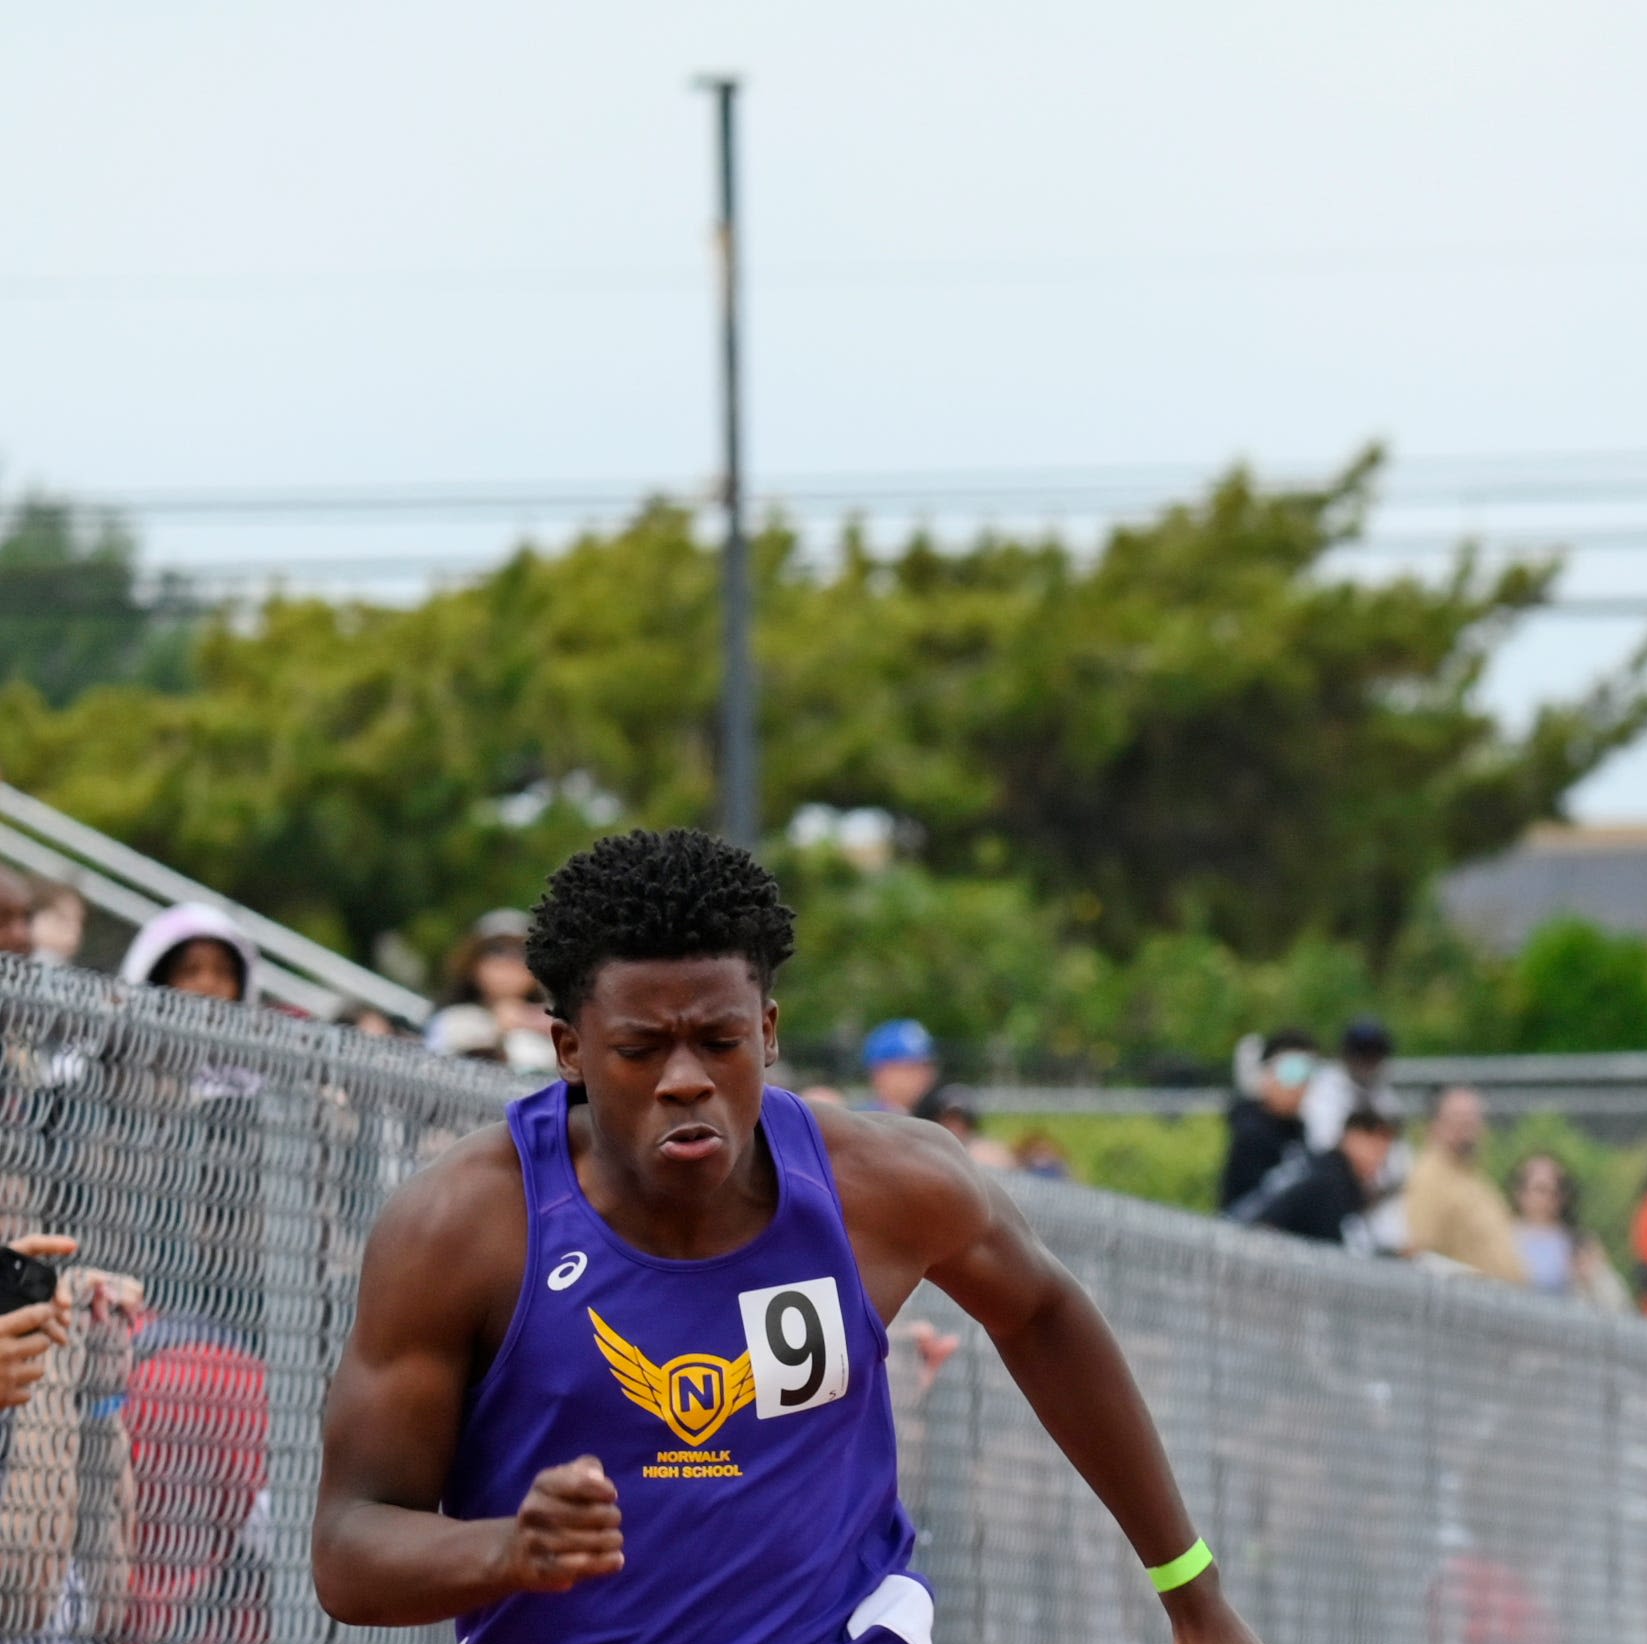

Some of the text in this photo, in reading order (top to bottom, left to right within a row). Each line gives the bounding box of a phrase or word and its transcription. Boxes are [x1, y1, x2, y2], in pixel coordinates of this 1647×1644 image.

[764, 1290, 826, 1407] 9
[679, 1373, 715, 1413] N
[657, 1451, 731, 1463] NORWALK
[642, 1464, 744, 1479] HIGH SCHOOL
